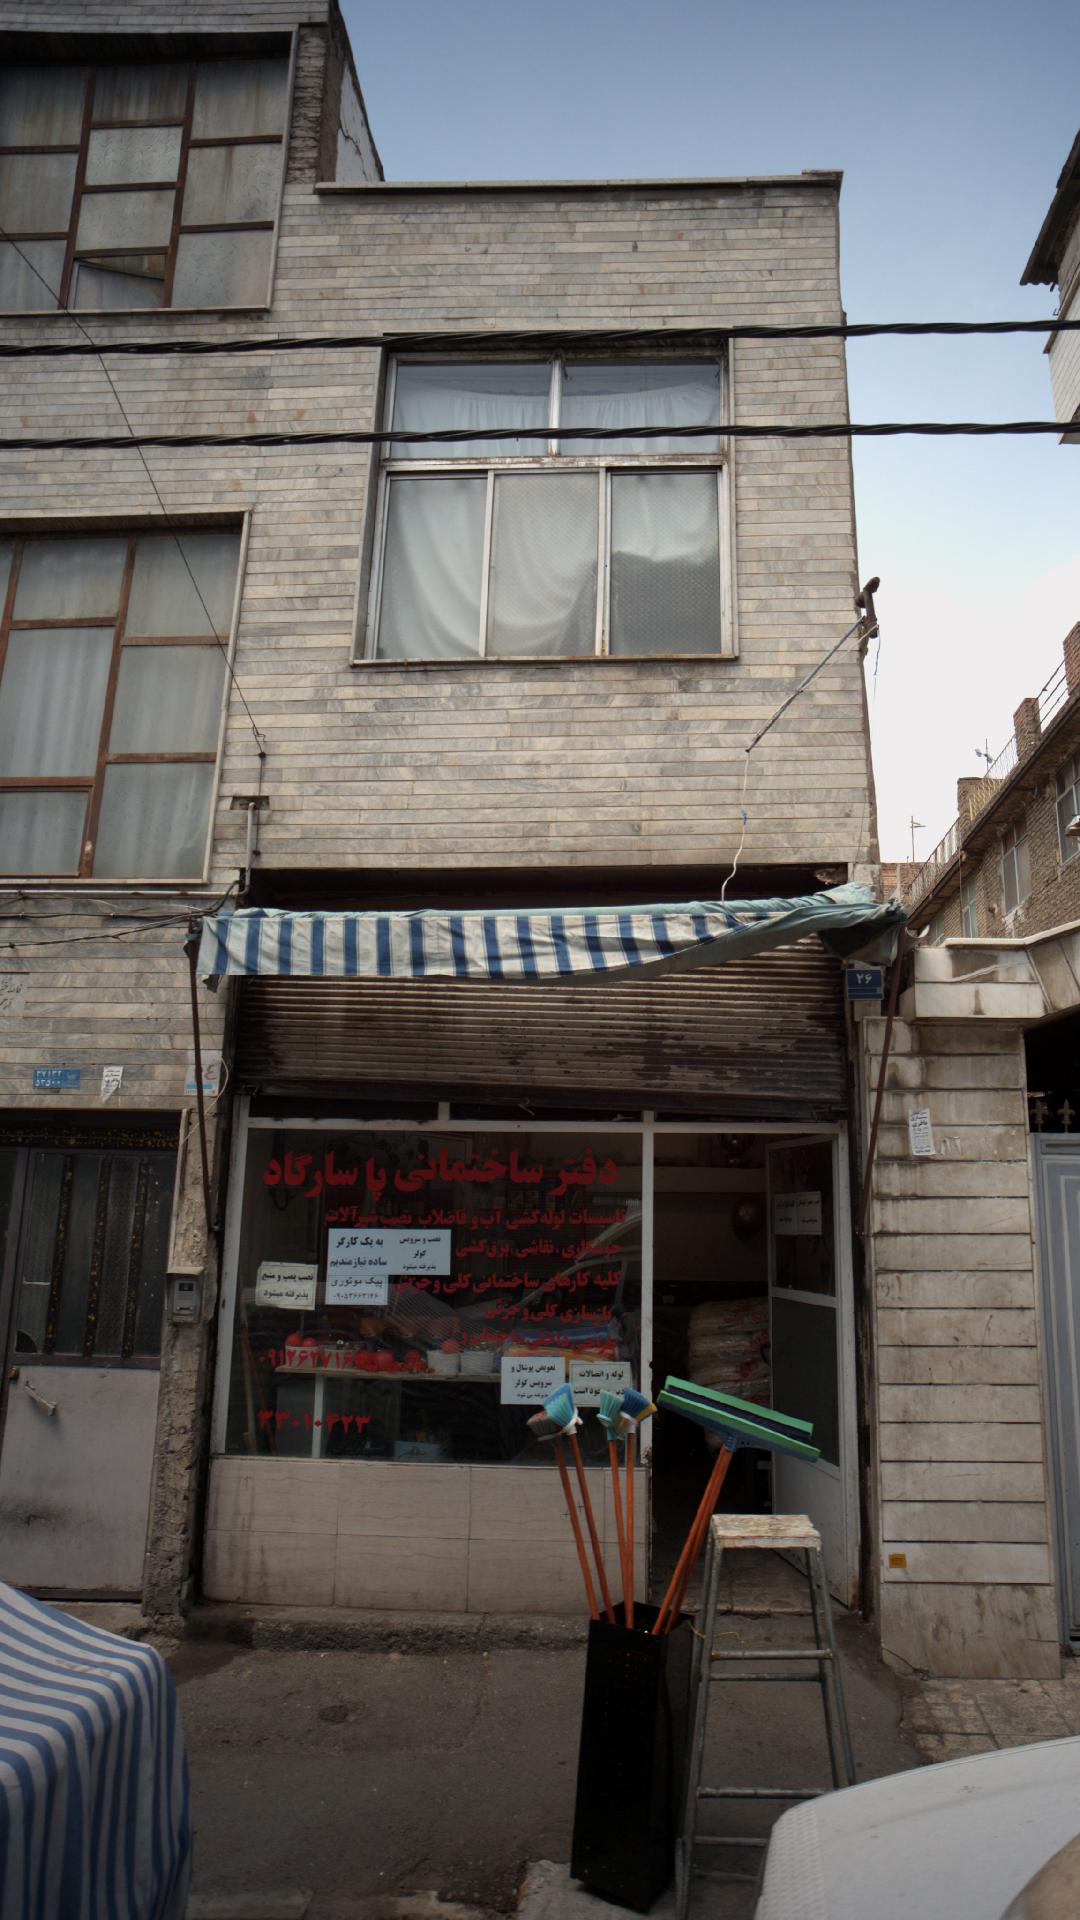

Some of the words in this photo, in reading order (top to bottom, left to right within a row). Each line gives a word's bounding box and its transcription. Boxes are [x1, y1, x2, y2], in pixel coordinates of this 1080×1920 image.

[856, 973, 873, 985] ۲۶
[394, 1146, 544, 1192] ساختمانی
[552, 1145, 618, 1196] دفتر
[336, 1236, 359, 1249] کارگر
[360, 1236, 374, 1248] یک
[375, 1239, 384, 1248] به
[399, 1237, 421, 1245] سرویس
[413, 1249, 427, 1259] کولر
[330, 1256, 367, 1269] نیازمندیم
[368, 1256, 387, 1267] ساده
[298, 1273, 314, 1281] نصب
[331, 1276, 363, 1288] موتوری
[366, 1277, 383, 1289] پیک
[442, 1271, 472, 1295] کلی
[472, 1271, 541, 1294] ساختمانی
[592, 1270, 623, 1290] کلیه
[433, 1279, 440, 1296] و
[285, 1288, 309, 1300] پذیرفته
[579, 1369, 604, 1378] اتصالات
[611, 1370, 624, 1381] لوله
[514, 1379, 528, 1389] کولر
[530, 1381, 552, 1389] سرویس
[574, 1387, 588, 1395] است
